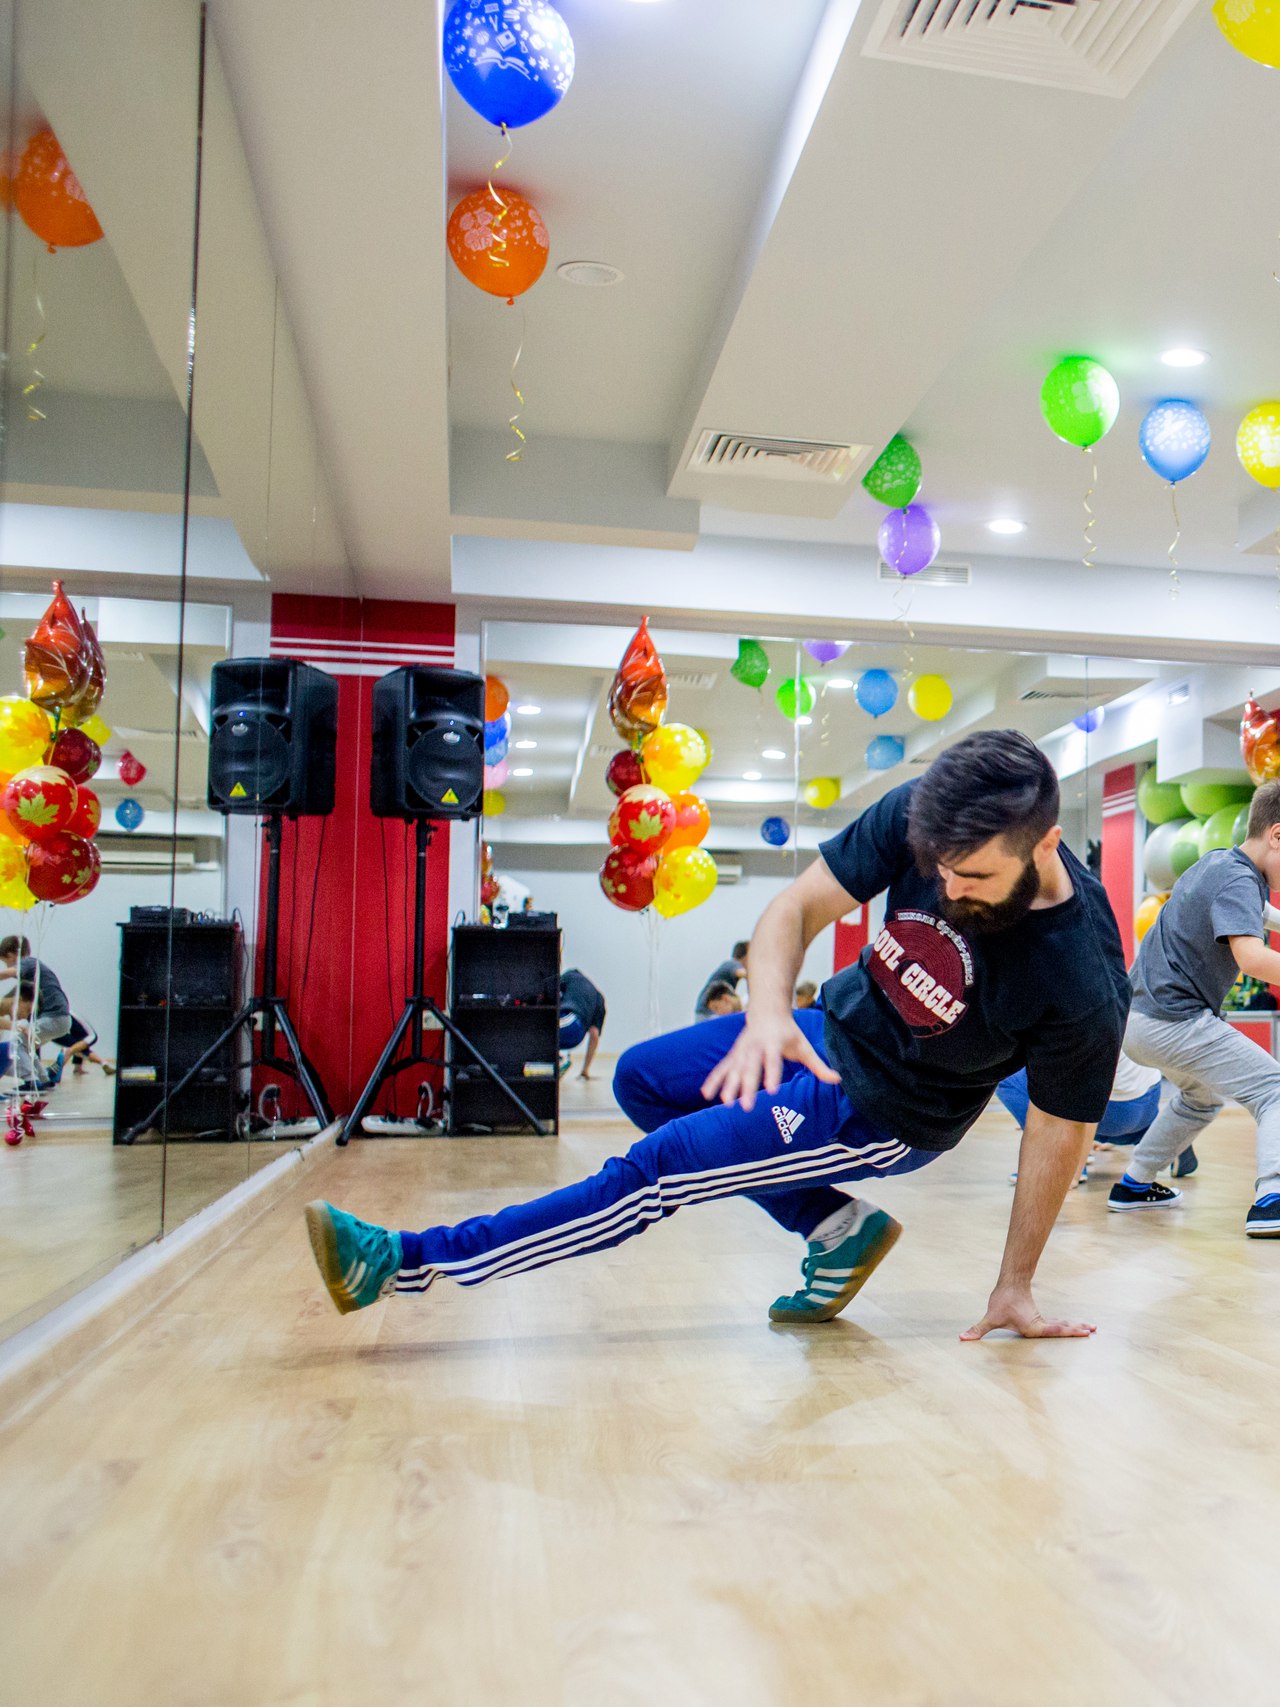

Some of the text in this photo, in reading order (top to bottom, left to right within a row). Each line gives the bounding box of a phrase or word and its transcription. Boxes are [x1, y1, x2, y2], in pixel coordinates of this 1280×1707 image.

[873, 929, 967, 1025] OUL CIRCLE
[771, 1105, 793, 1145] adidas
